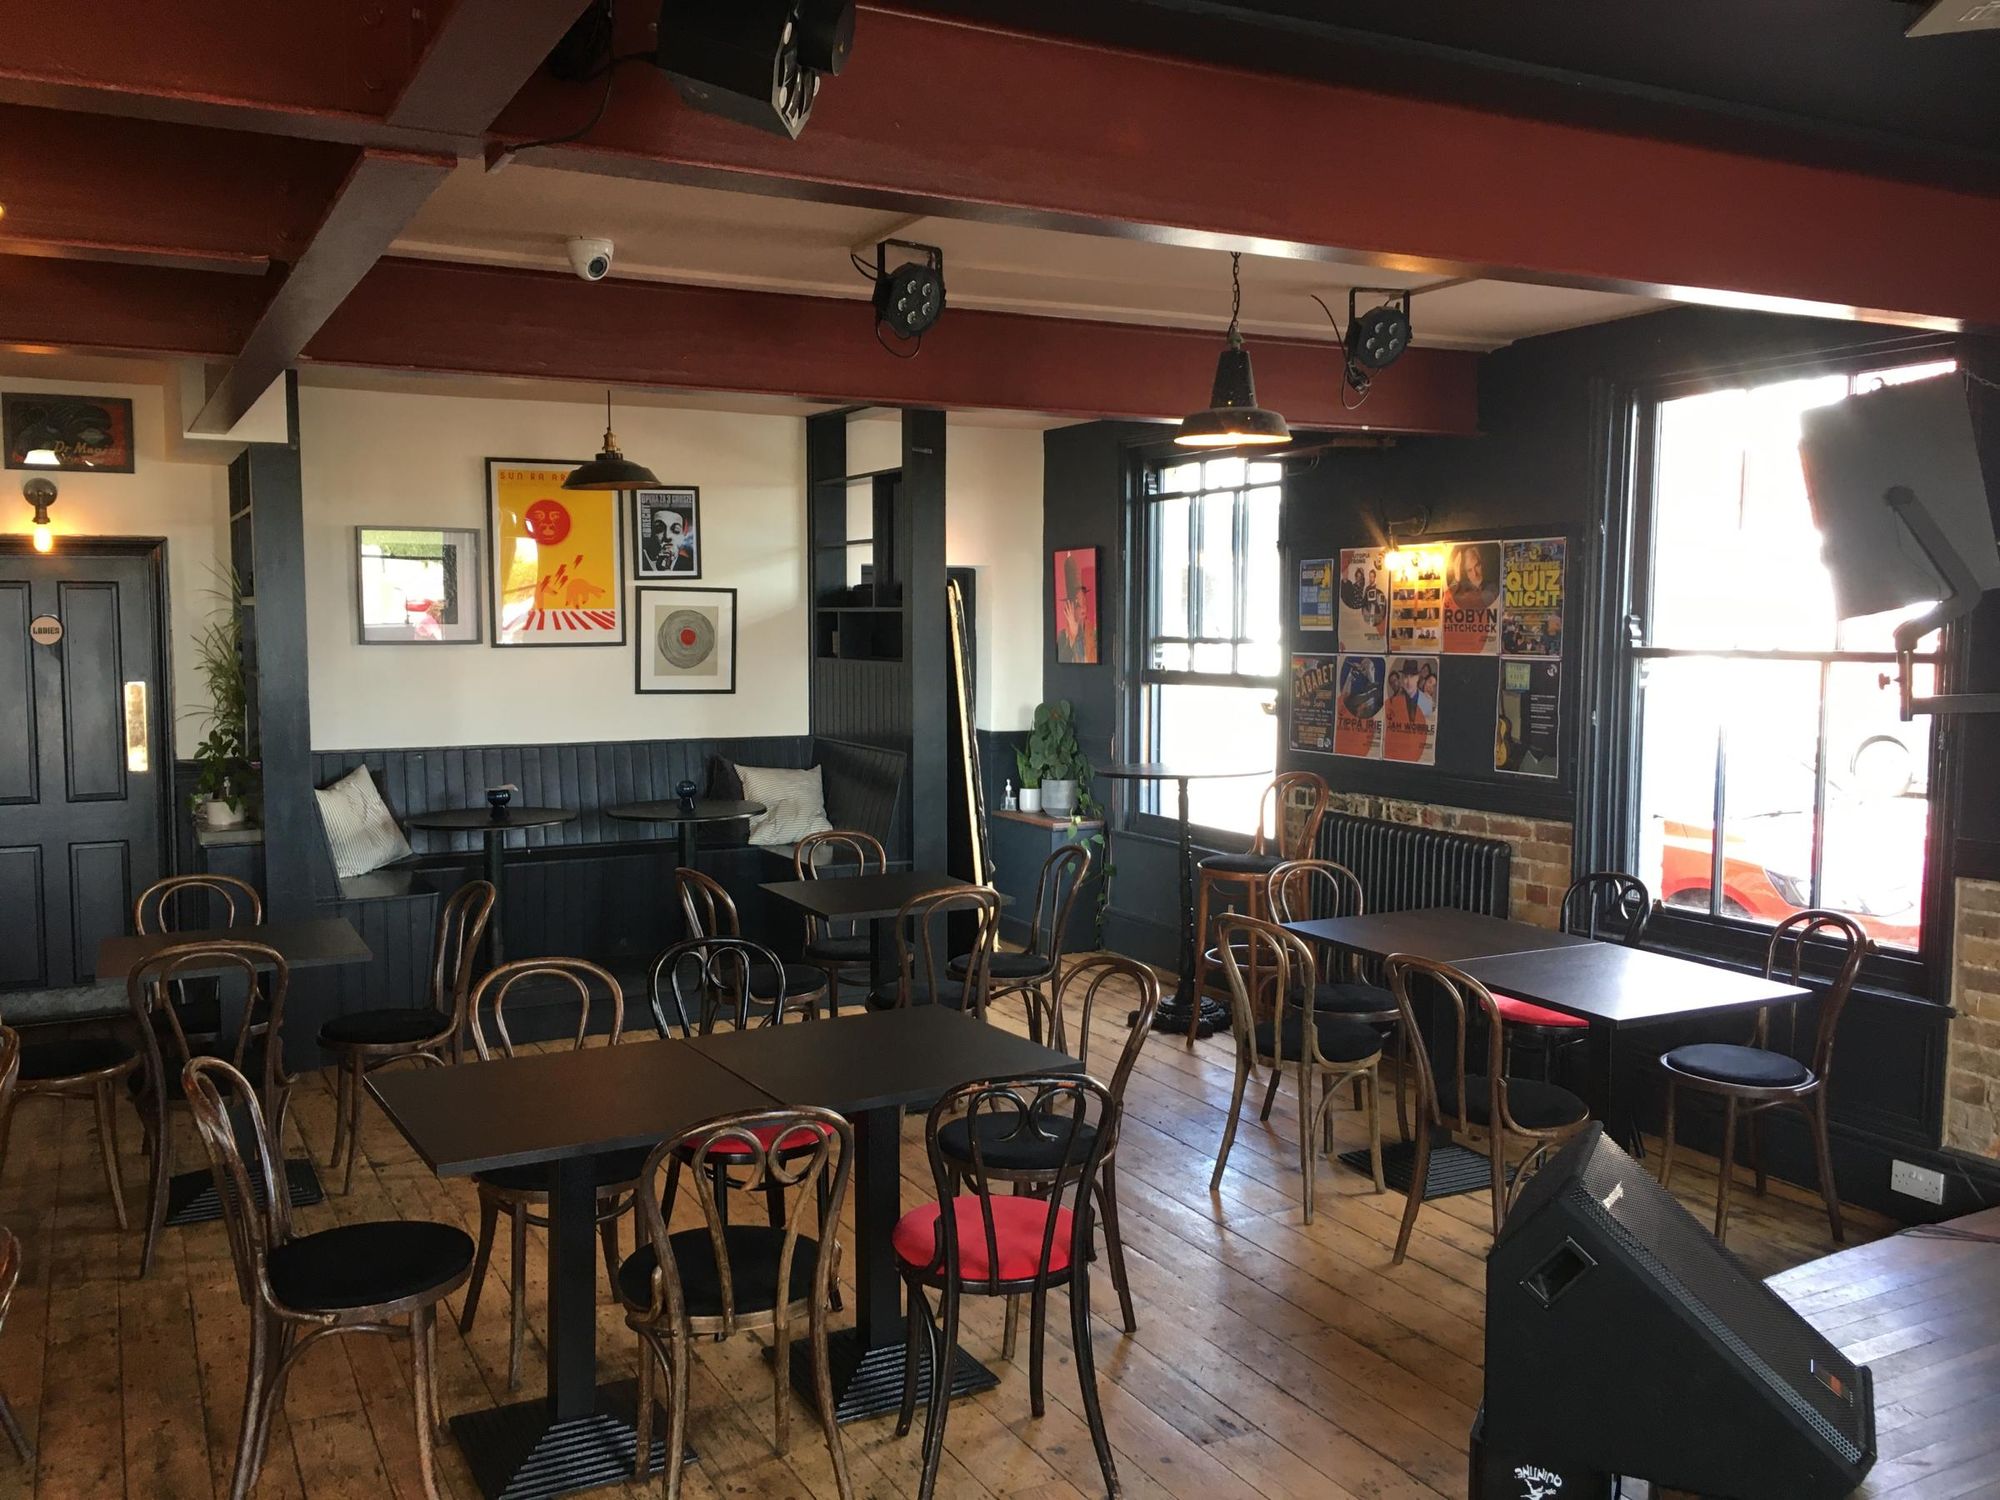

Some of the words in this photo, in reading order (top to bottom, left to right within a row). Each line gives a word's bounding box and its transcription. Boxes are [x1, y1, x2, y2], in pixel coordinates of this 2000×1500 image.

[500, 472, 523, 480] SUN
[1506, 571, 1560, 592] QUIZ
[1505, 591, 1560, 608] NIGHT
[1444, 609, 1498, 624] ROBYN
[33, 626, 60, 635] LADIES
[1444, 624, 1497, 633] HITCHCOCK
[1295, 663, 1334, 698] CABARET
[1338, 719, 1362, 729] TIPPA
[1366, 720, 1383, 731] IRIE
